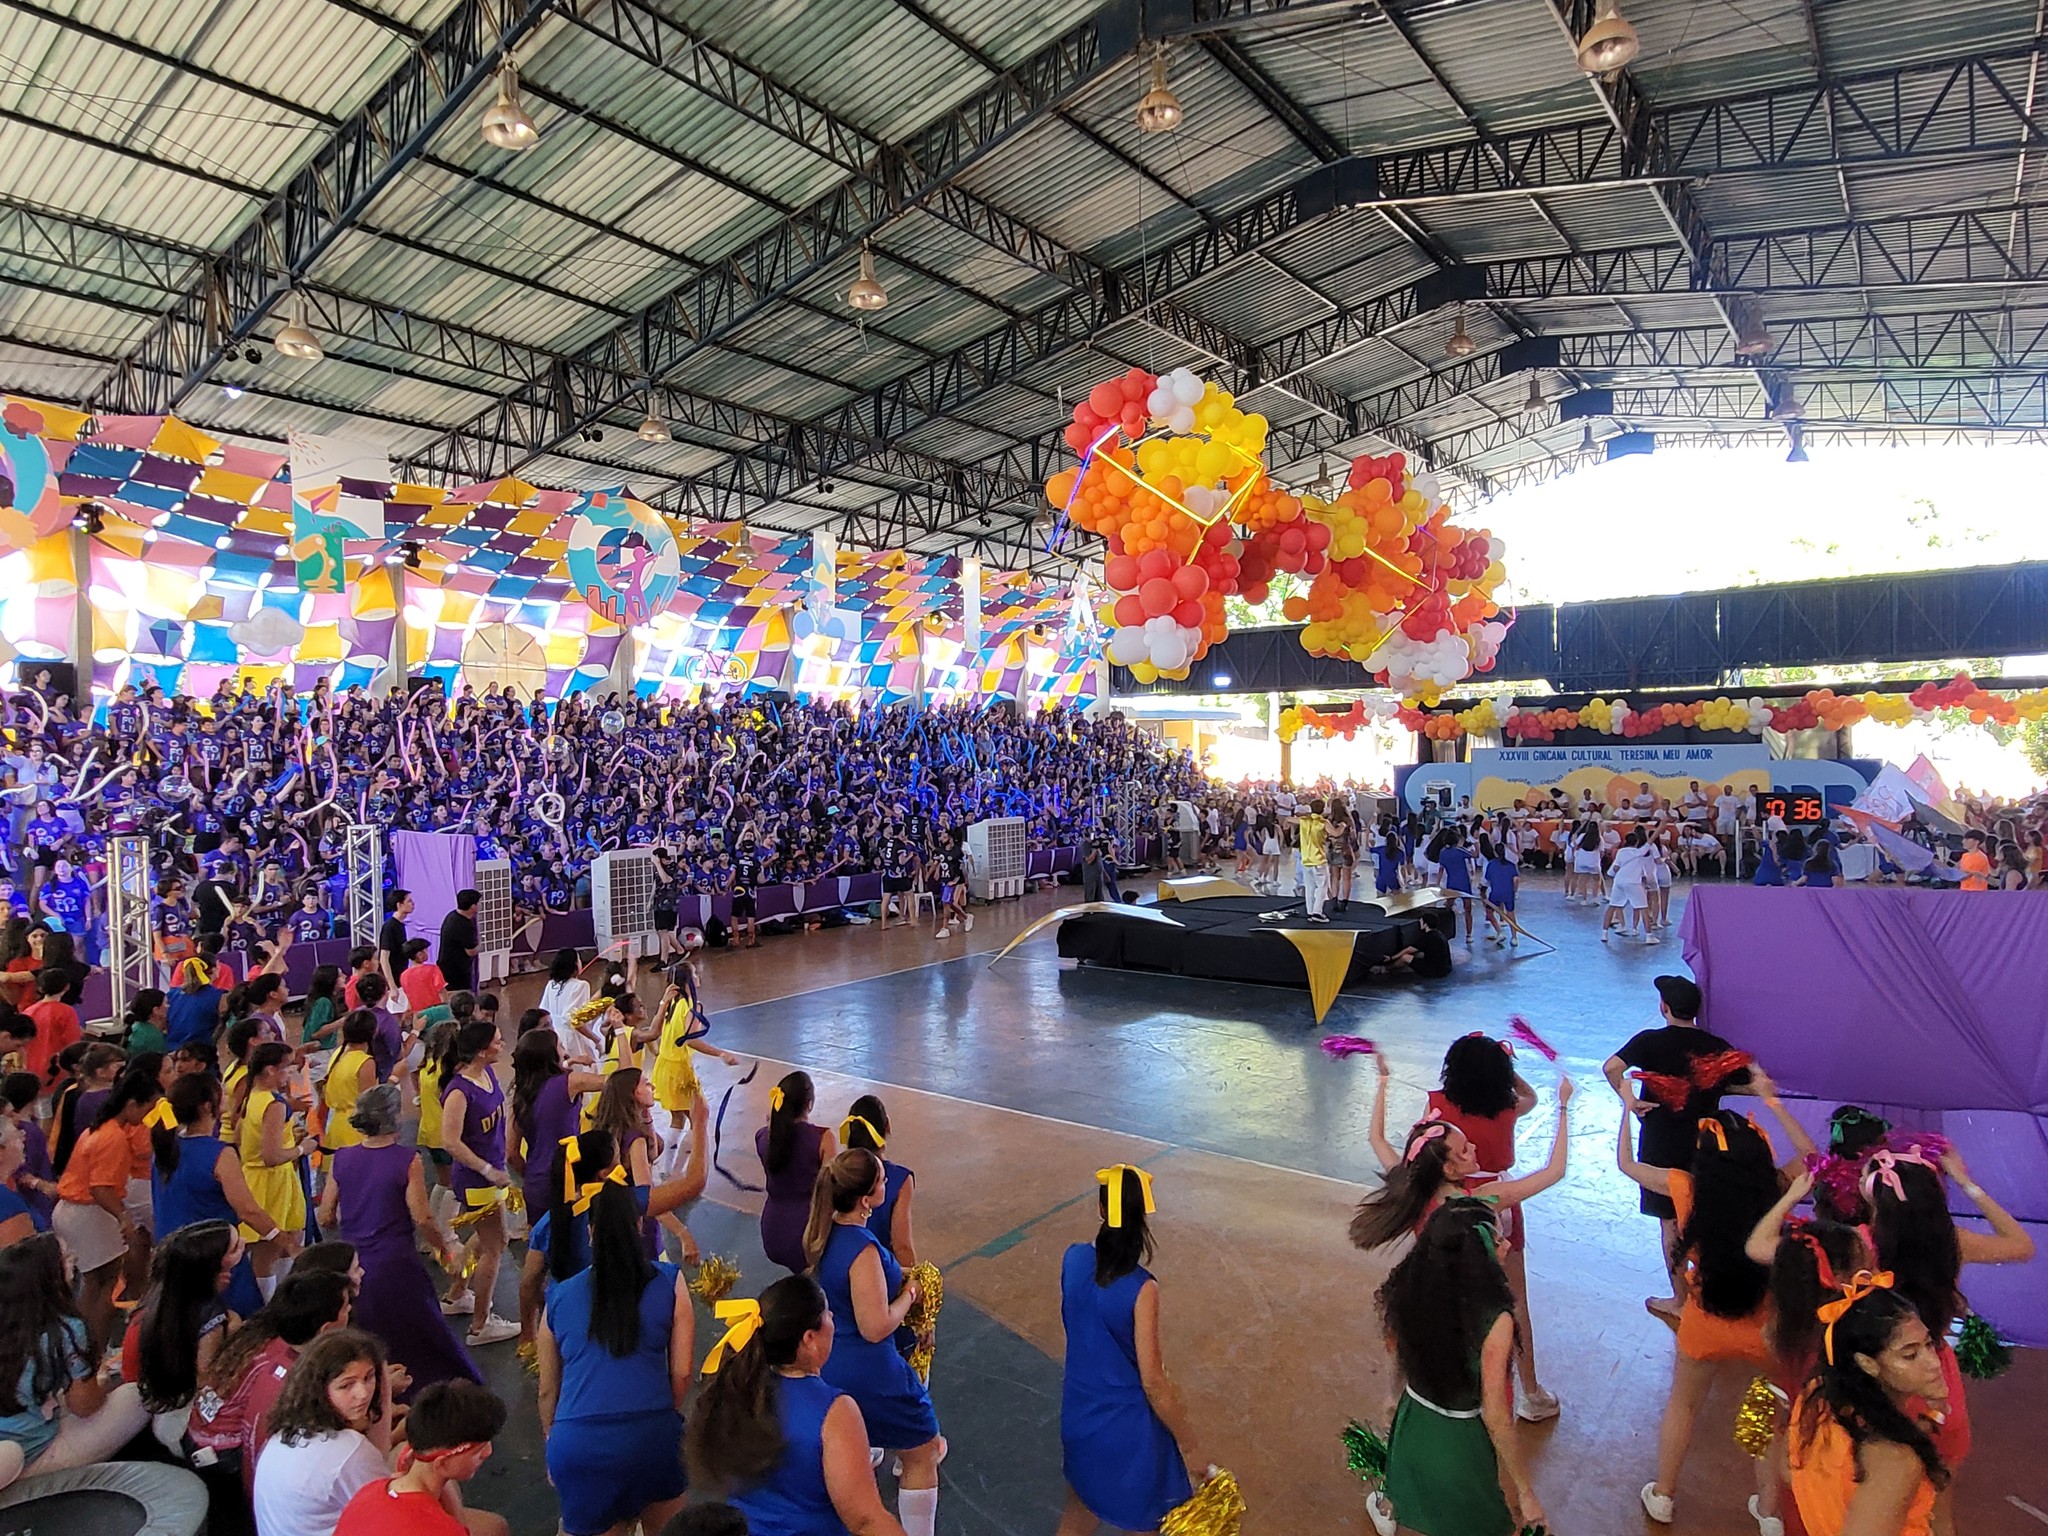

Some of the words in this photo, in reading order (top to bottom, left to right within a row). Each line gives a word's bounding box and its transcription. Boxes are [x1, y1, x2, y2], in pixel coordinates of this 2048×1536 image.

[1498, 750, 1529, 760] XXXVIII
[1533, 750, 1567, 760] GINCANA
[1571, 750, 1613, 760] CULTURAL
[1620, 750, 1659, 760] TERESINA
[1663, 749, 1680, 760] MEU
[1685, 748, 1713, 759] AMOR
[1793, 799, 1821, 820] 36
[886, 848, 892, 859] 5
[742, 866, 748, 876] 5
[301, 930, 320, 941] FO
